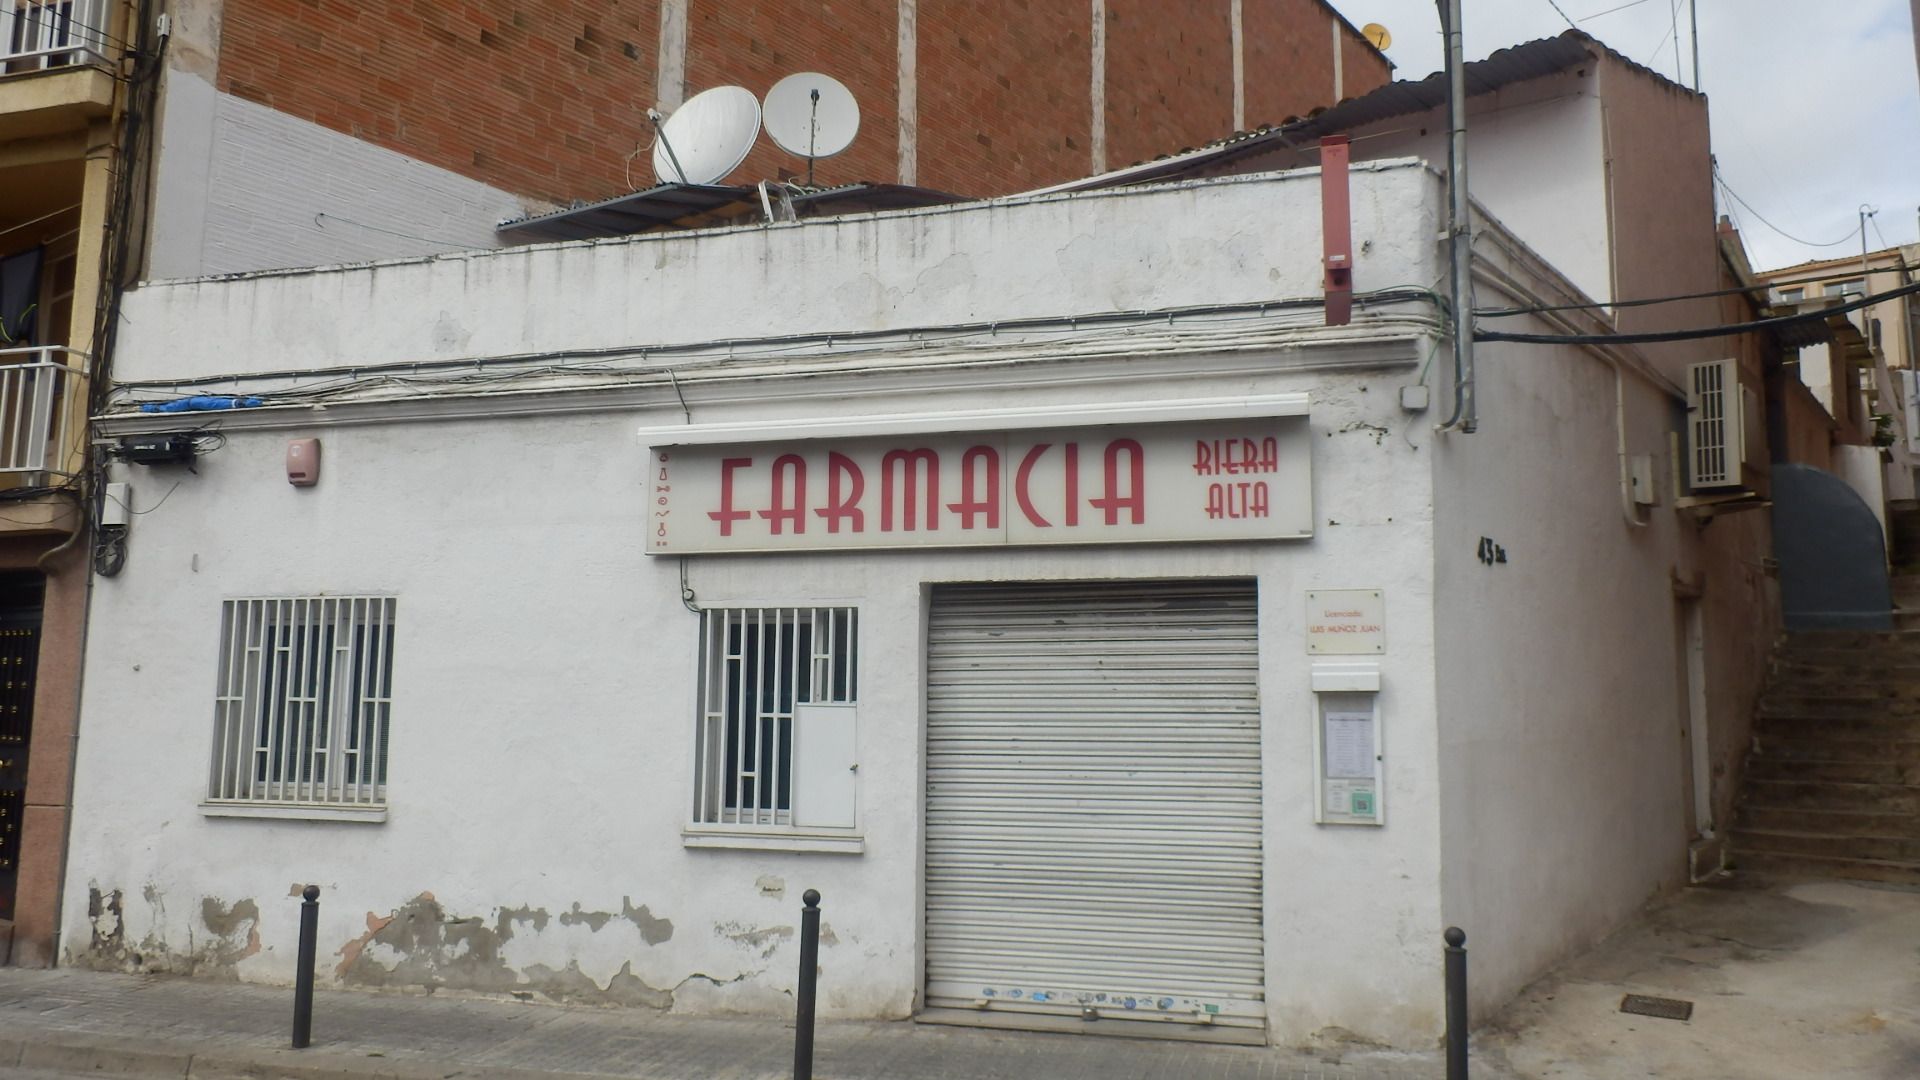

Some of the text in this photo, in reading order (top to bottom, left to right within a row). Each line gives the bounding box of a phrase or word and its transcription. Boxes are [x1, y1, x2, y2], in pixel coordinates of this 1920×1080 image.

[1192, 436, 1278, 476] RIERA
[707, 438, 1145, 537] FARMACIA
[1204, 481, 1269, 519] ALTA
[1360, 624, 1381, 633] JUAN
